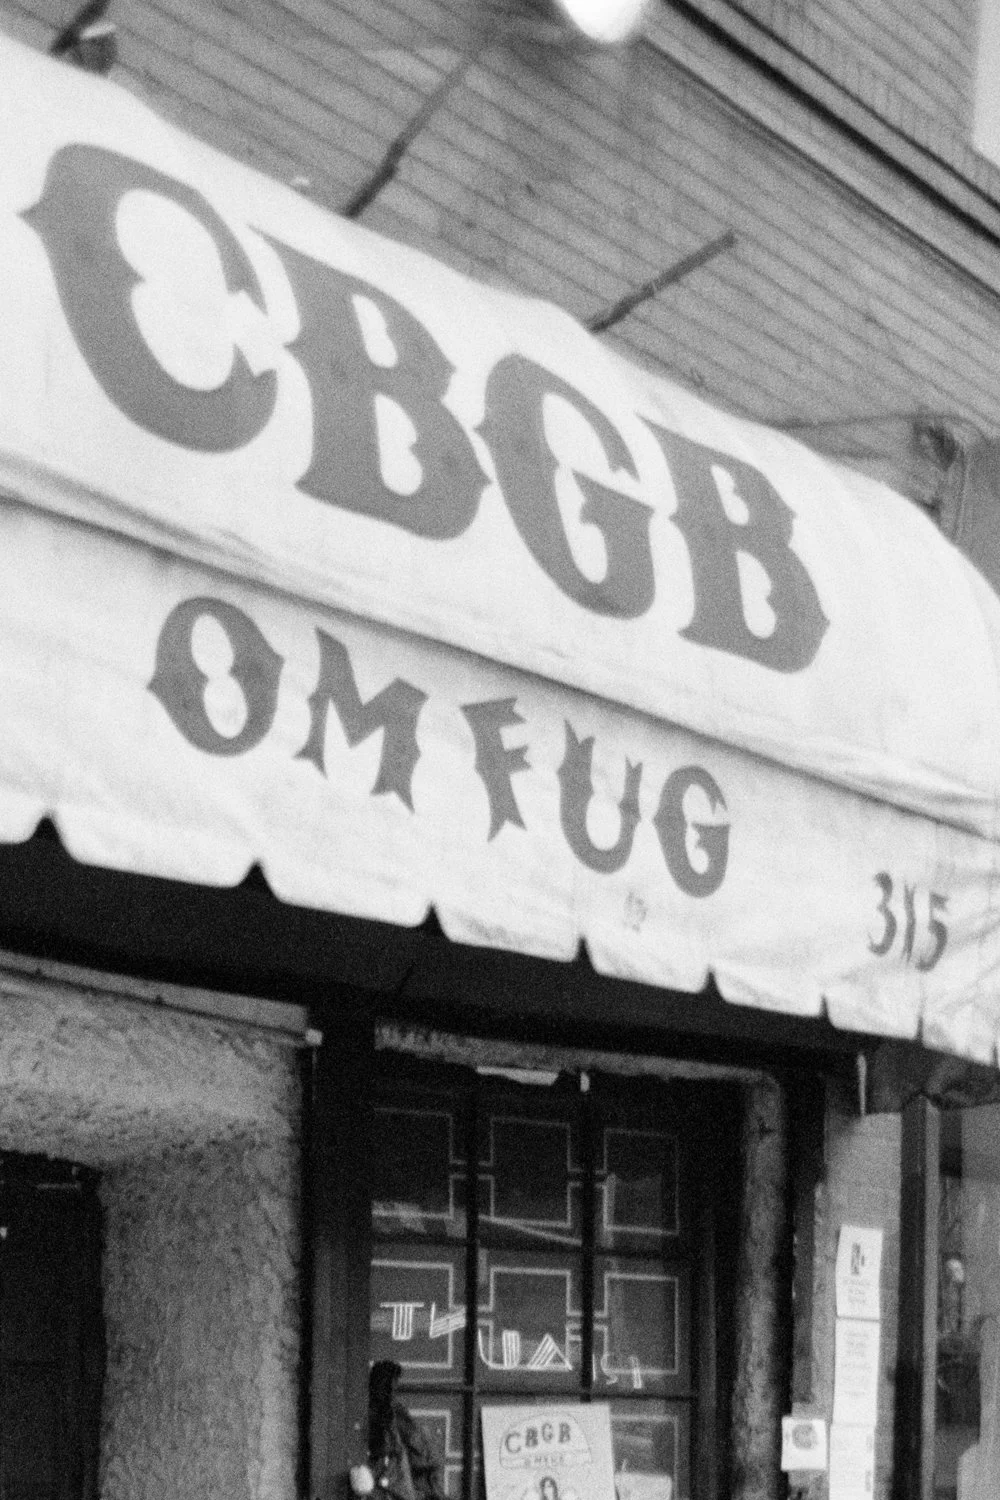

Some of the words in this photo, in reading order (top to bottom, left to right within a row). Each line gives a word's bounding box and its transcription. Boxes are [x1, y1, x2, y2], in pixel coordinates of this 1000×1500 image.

[17, 142, 831, 674] CBGB
[147, 595, 731, 899] OMFUG
[867, 870, 949, 972] 315
